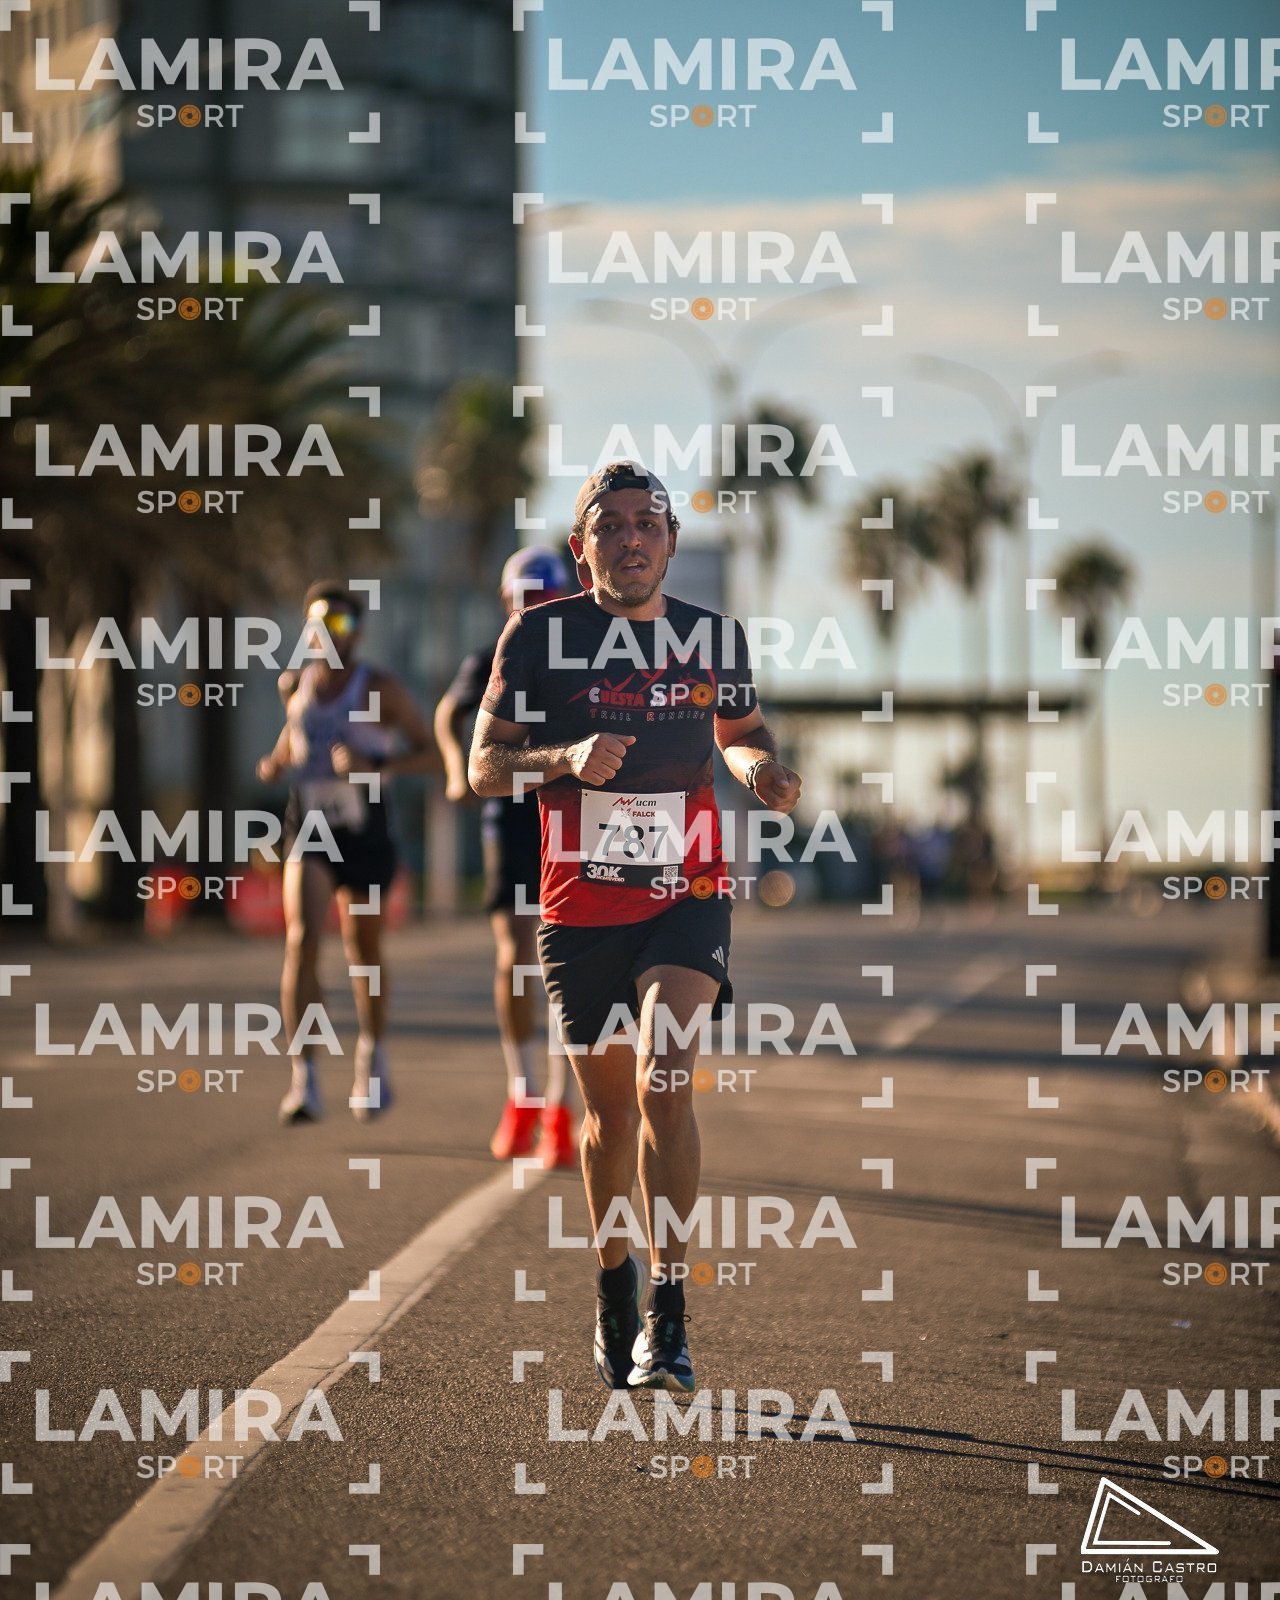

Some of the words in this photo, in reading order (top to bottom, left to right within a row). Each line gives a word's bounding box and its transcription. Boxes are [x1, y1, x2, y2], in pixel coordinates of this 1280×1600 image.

[635, 799, 657, 807] ucm
[632, 810, 656, 818] FALCK
[598, 823, 669, 859] 787
[586, 863, 622, 879] 30K
